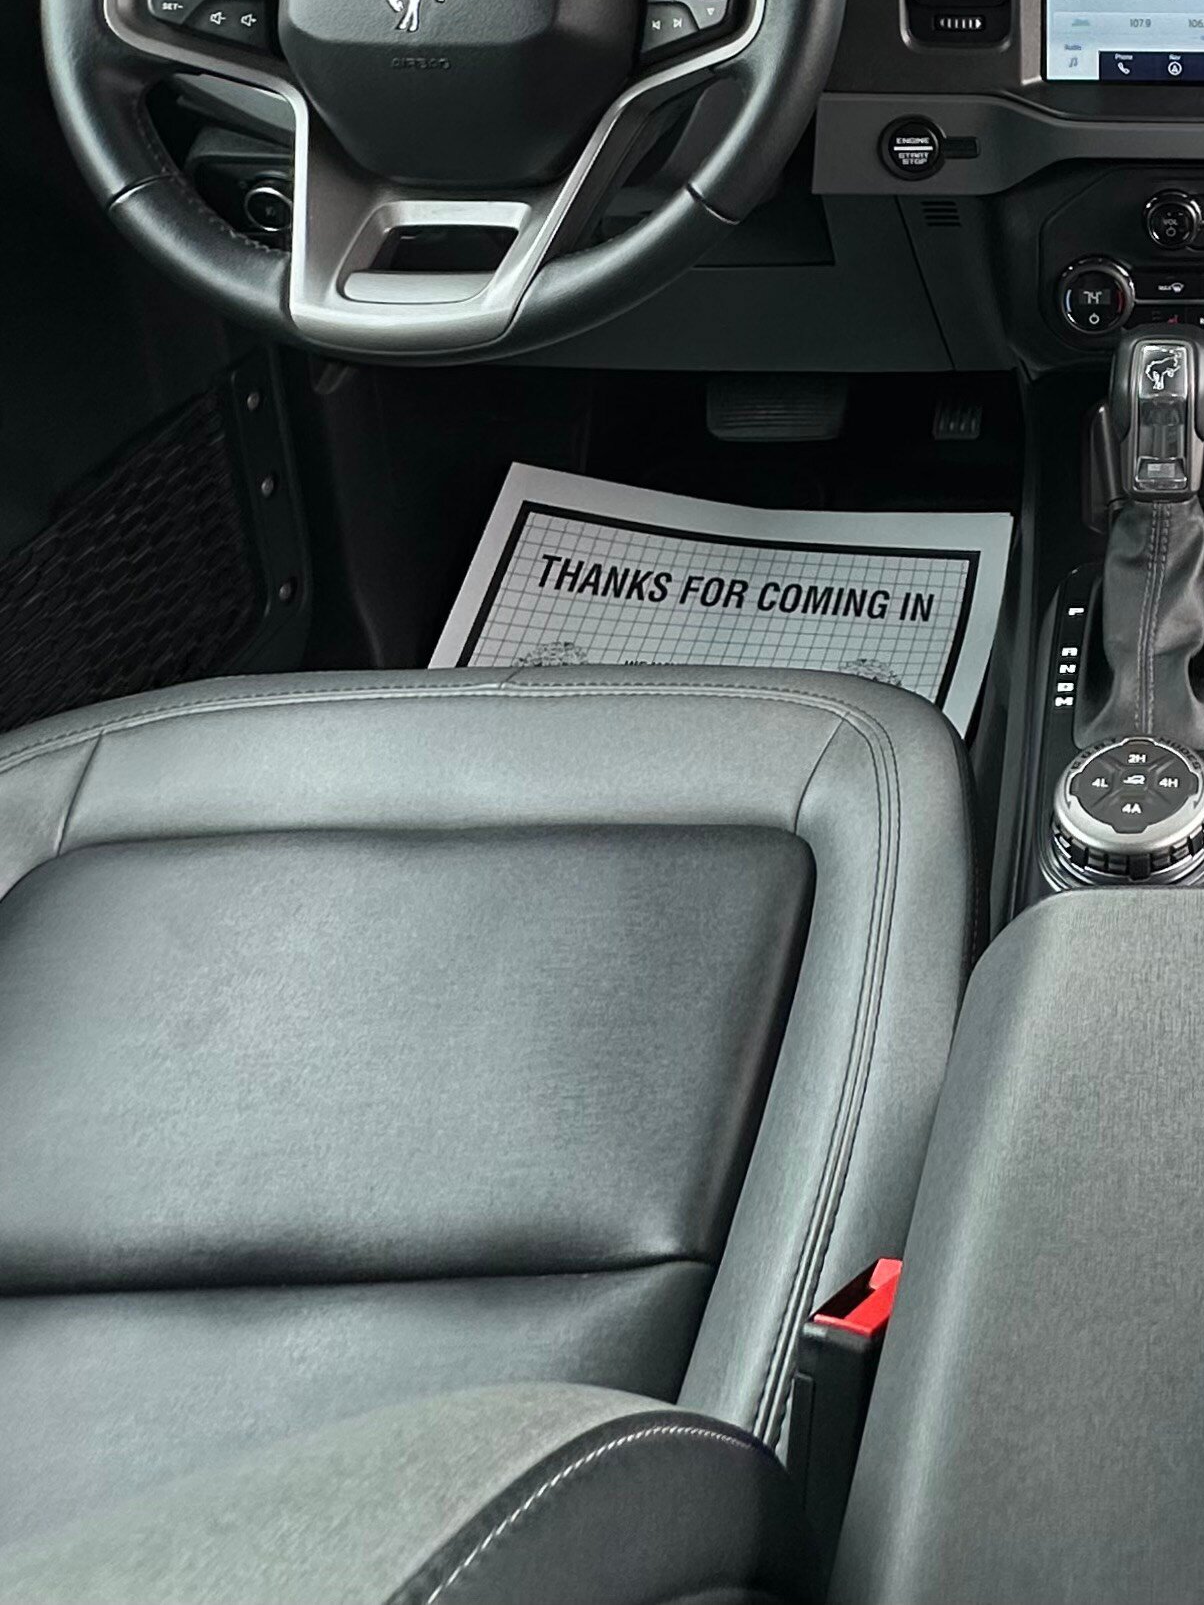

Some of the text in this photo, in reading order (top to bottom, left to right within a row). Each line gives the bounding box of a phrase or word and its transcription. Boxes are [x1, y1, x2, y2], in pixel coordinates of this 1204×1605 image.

[538, 554, 935, 622] THANKS FOR COMING IN
[1128, 754, 1146, 763] 2H
[1092, 778, 1109, 788] 4L
[1158, 778, 1178, 788] 4H
[1121, 803, 1142, 814] 4A
